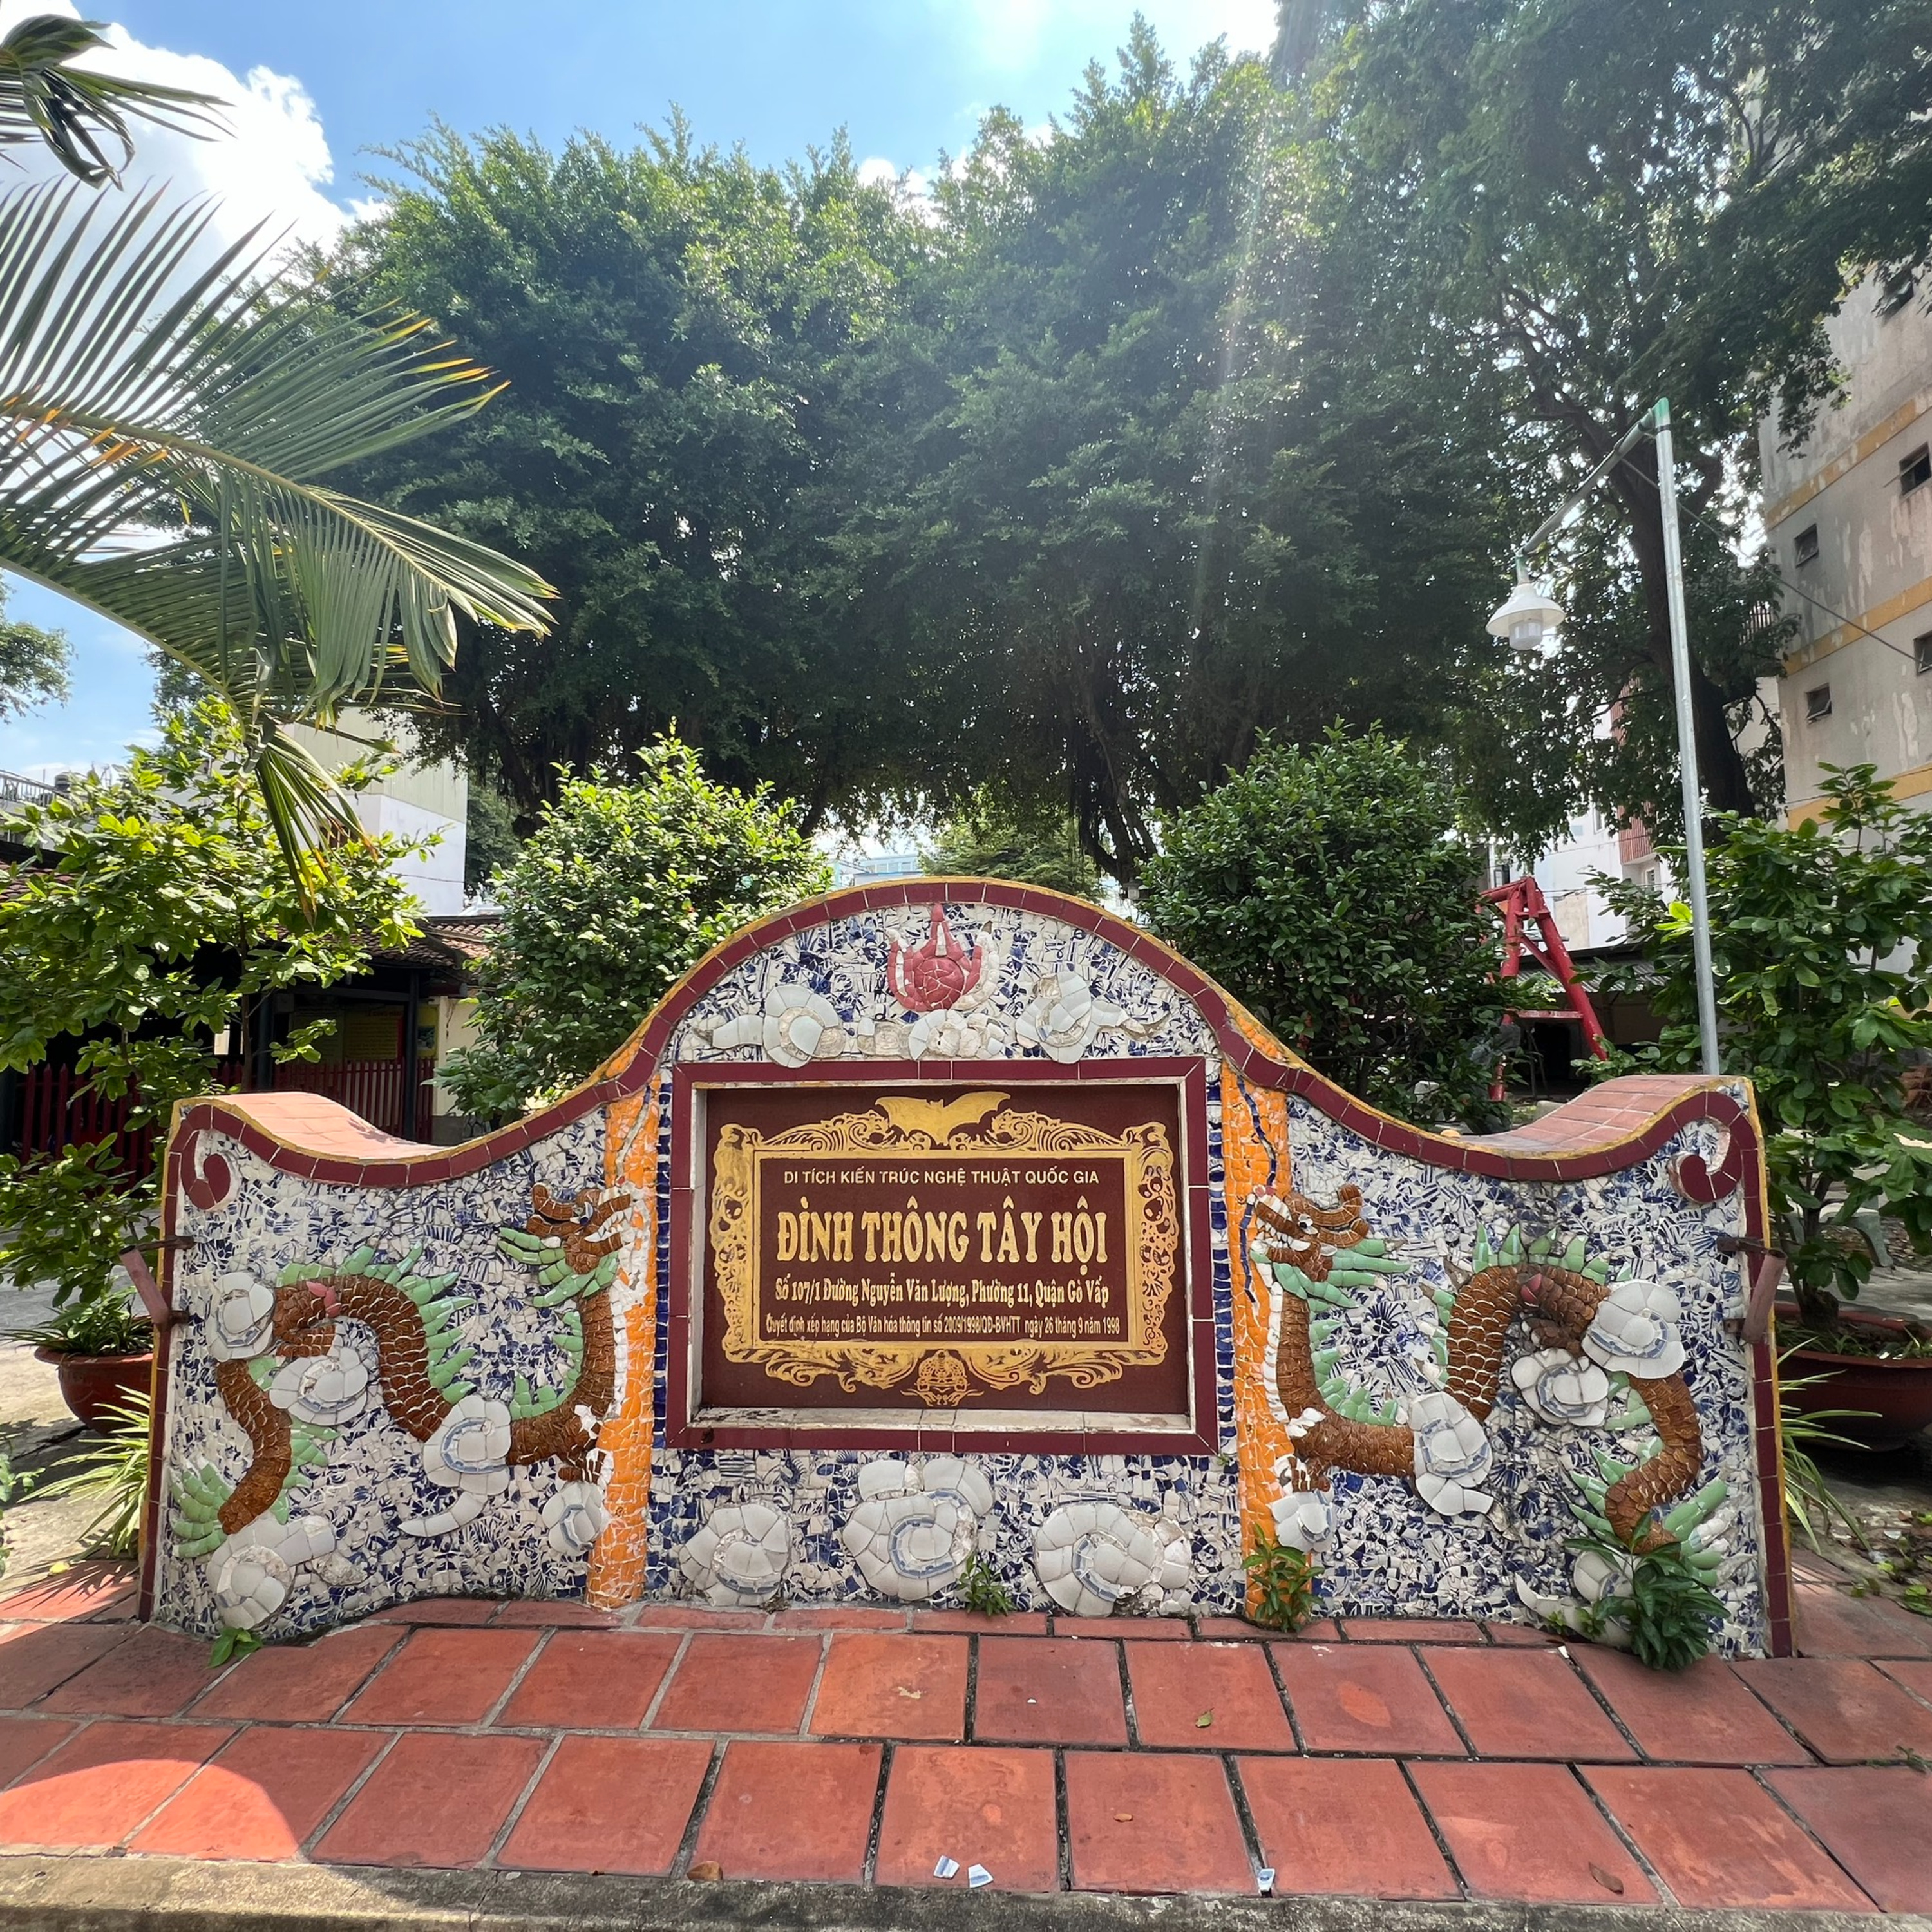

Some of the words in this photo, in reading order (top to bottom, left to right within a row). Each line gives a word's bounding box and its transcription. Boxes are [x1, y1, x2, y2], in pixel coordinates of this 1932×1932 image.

[784, 1171, 798, 1184] DI
[802, 1168, 835, 1184] TÍCH
[840, 1166, 875, 1184] KIẾN
[879, 1168, 920, 1184] TRÚC
[925, 1168, 966, 1186] NGHỆ
[971, 1168, 1021, 1186] THUẬT
[1025, 1166, 1068, 1184] QUỐC
[1074, 1171, 1099, 1184] GIA
[777, 1196, 853, 1262] ĐÌNH
[861, 1195, 969, 1263] THÔNG
[976, 1195, 1043, 1263] TÂY
[1050, 1195, 1108, 1276] HỘI
[775, 1273, 791, 1300] Số
[791, 1278, 820, 1305] 107/1
[823, 1277, 858, 1307] Đường
[861, 1272, 904, 1307] Nguyễn
[905, 1278, 929, 1302] Văn
[931, 1278, 969, 1308] Lượng,
[971, 1278, 1014, 1308] Phường
[1017, 1282, 1032, 1307] 11,
[1035, 1279, 1064, 1308] Quận
[1068, 1279, 1083, 1303] Gò
[1085, 1275, 1109, 1308] Vấp
[822, 1316, 840, 1338] hạng
[841, 1314, 855, 1333] của
[856, 1315, 866, 1336] Bộ
[884, 1315, 898, 1333] hóa
[899, 1315, 920, 1338] thông
[922, 1316, 932, 1333] tin
[934, 1312, 943, 1333] số
[1025, 1316, 1043, 1338] ngày
[1045, 1316, 1054, 1334] 26
[1055, 1316, 1077, 1338] tháng
[1077, 1317, 1083, 1334] 9
[1084, 1316, 1101, 1334] năm
[1103, 1317, 1120, 1334] 1998
